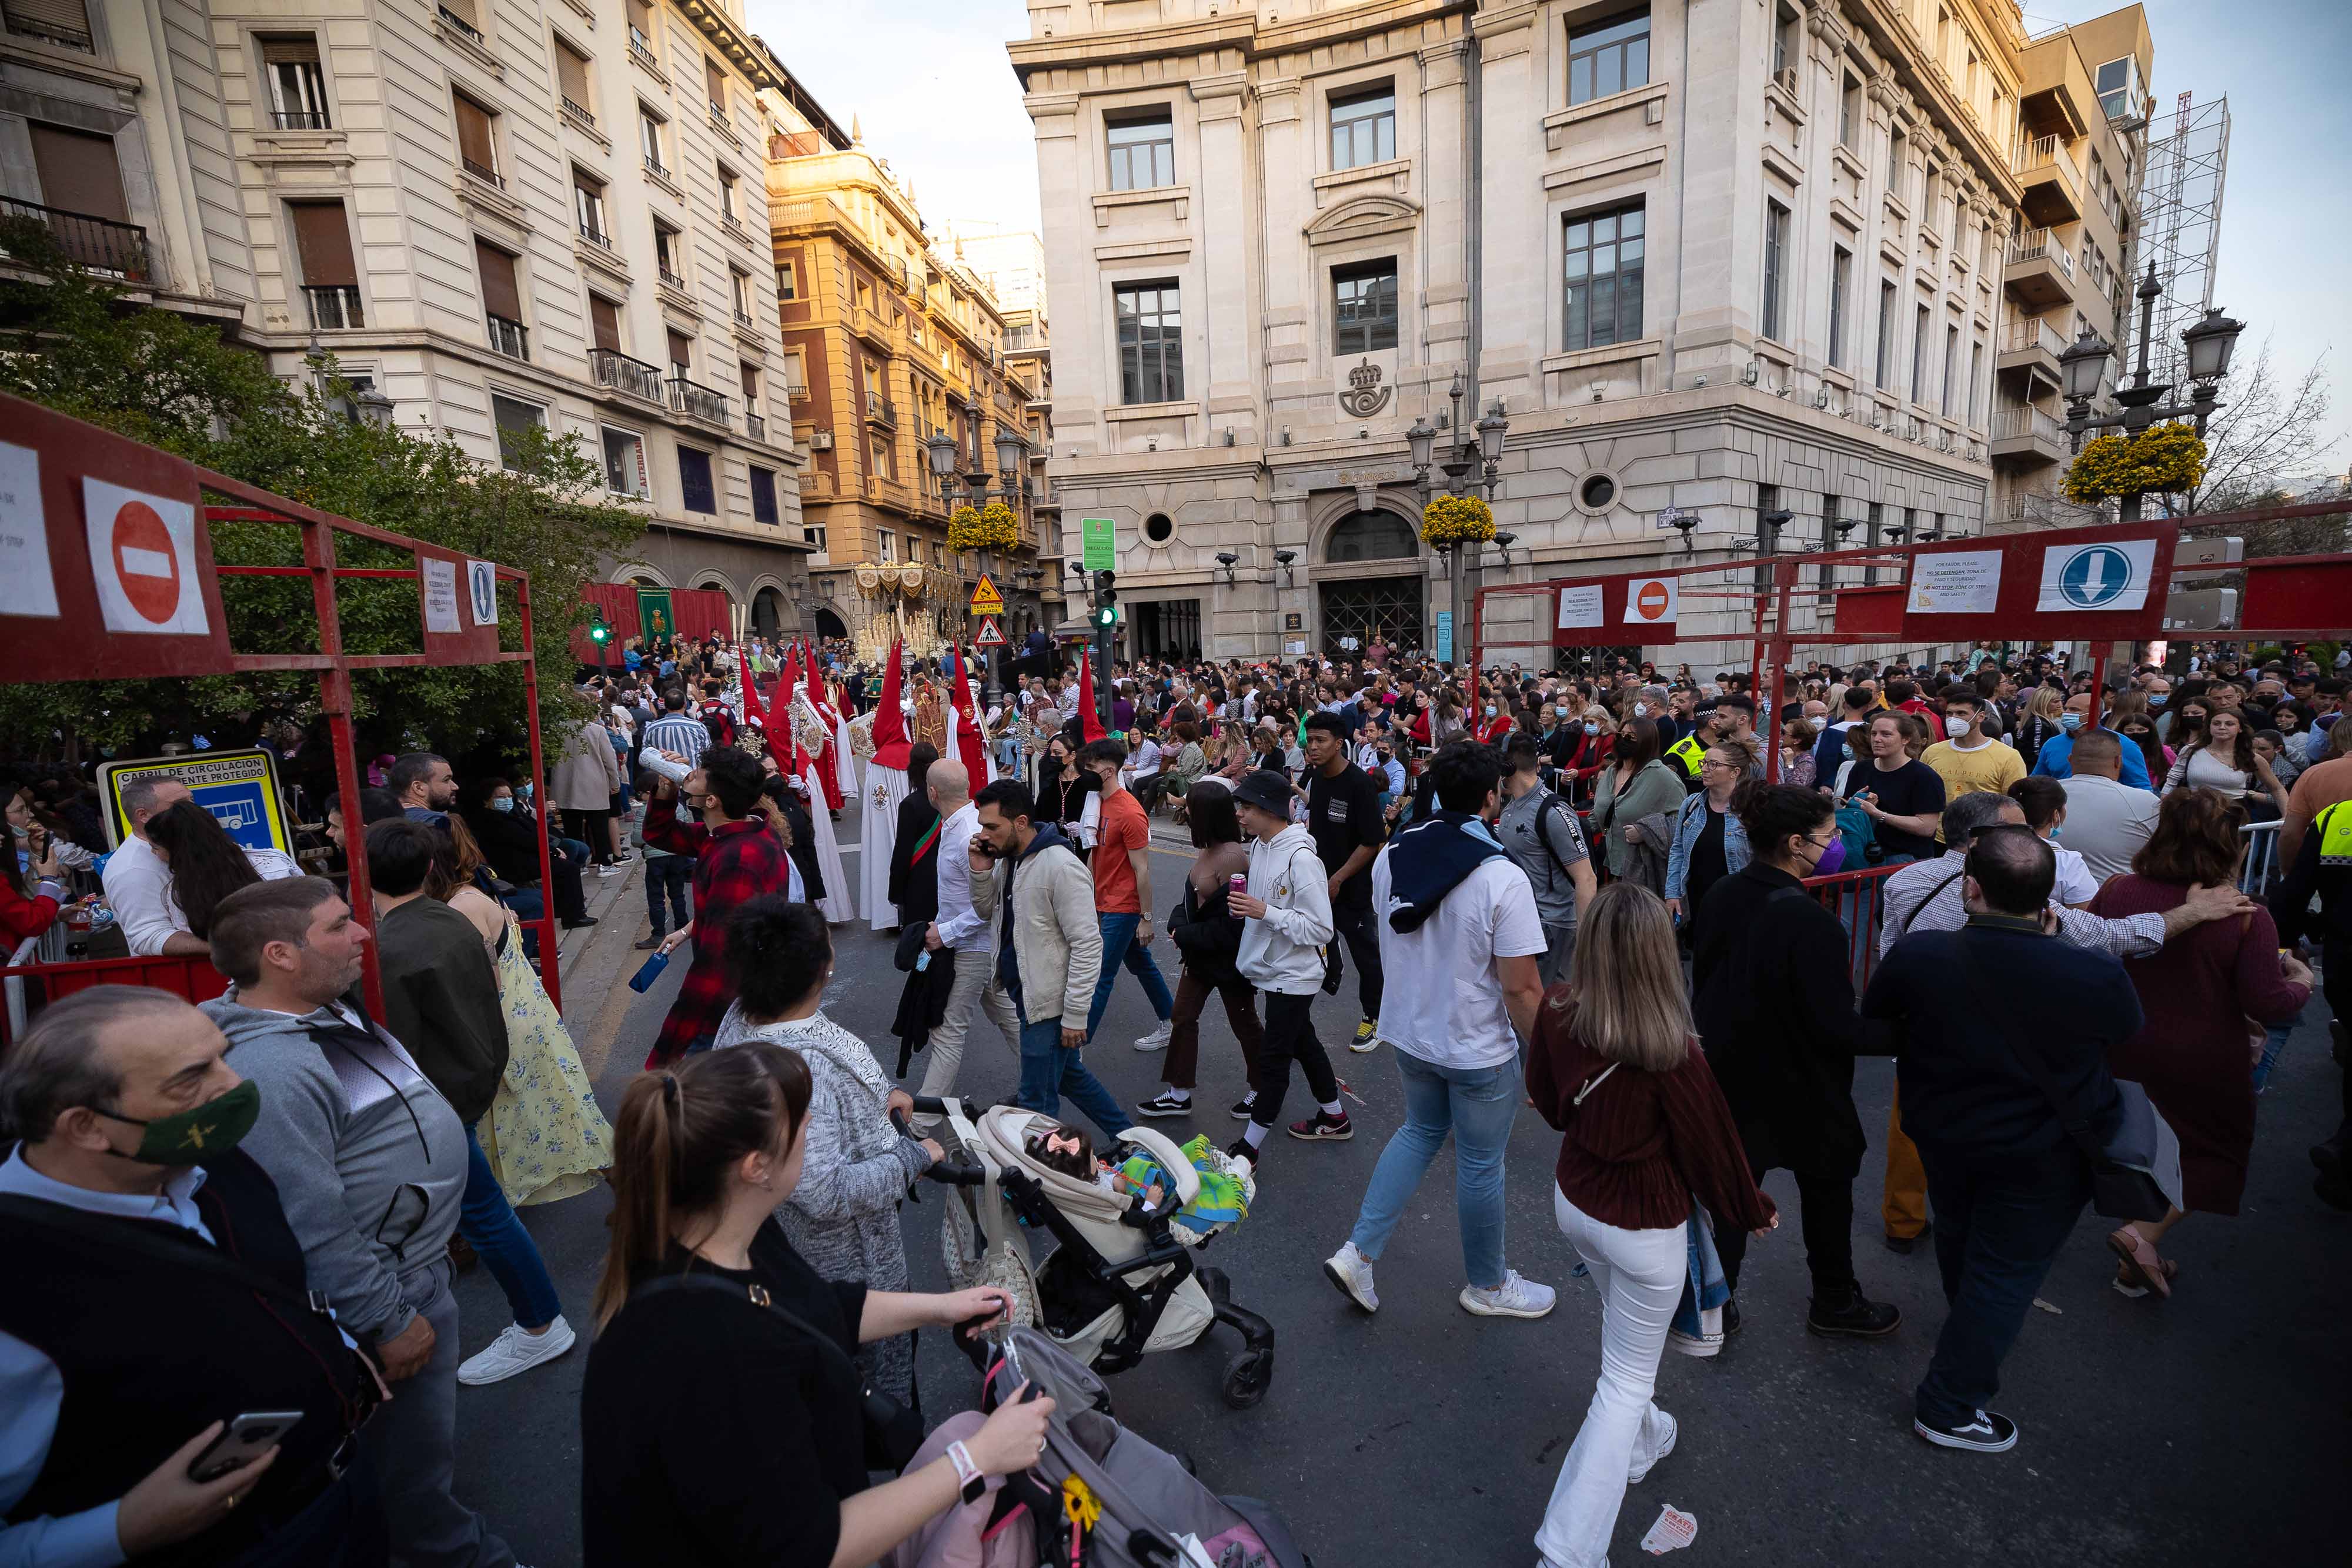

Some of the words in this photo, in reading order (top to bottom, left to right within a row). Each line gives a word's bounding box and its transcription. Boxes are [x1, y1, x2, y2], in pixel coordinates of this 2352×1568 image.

[1352, 470, 1398, 483] CORREOS
[169, 768, 183, 776] DE
[188, 758, 260, 775] CIRCULACION
[211, 768, 263, 783] PROTEGIDO
